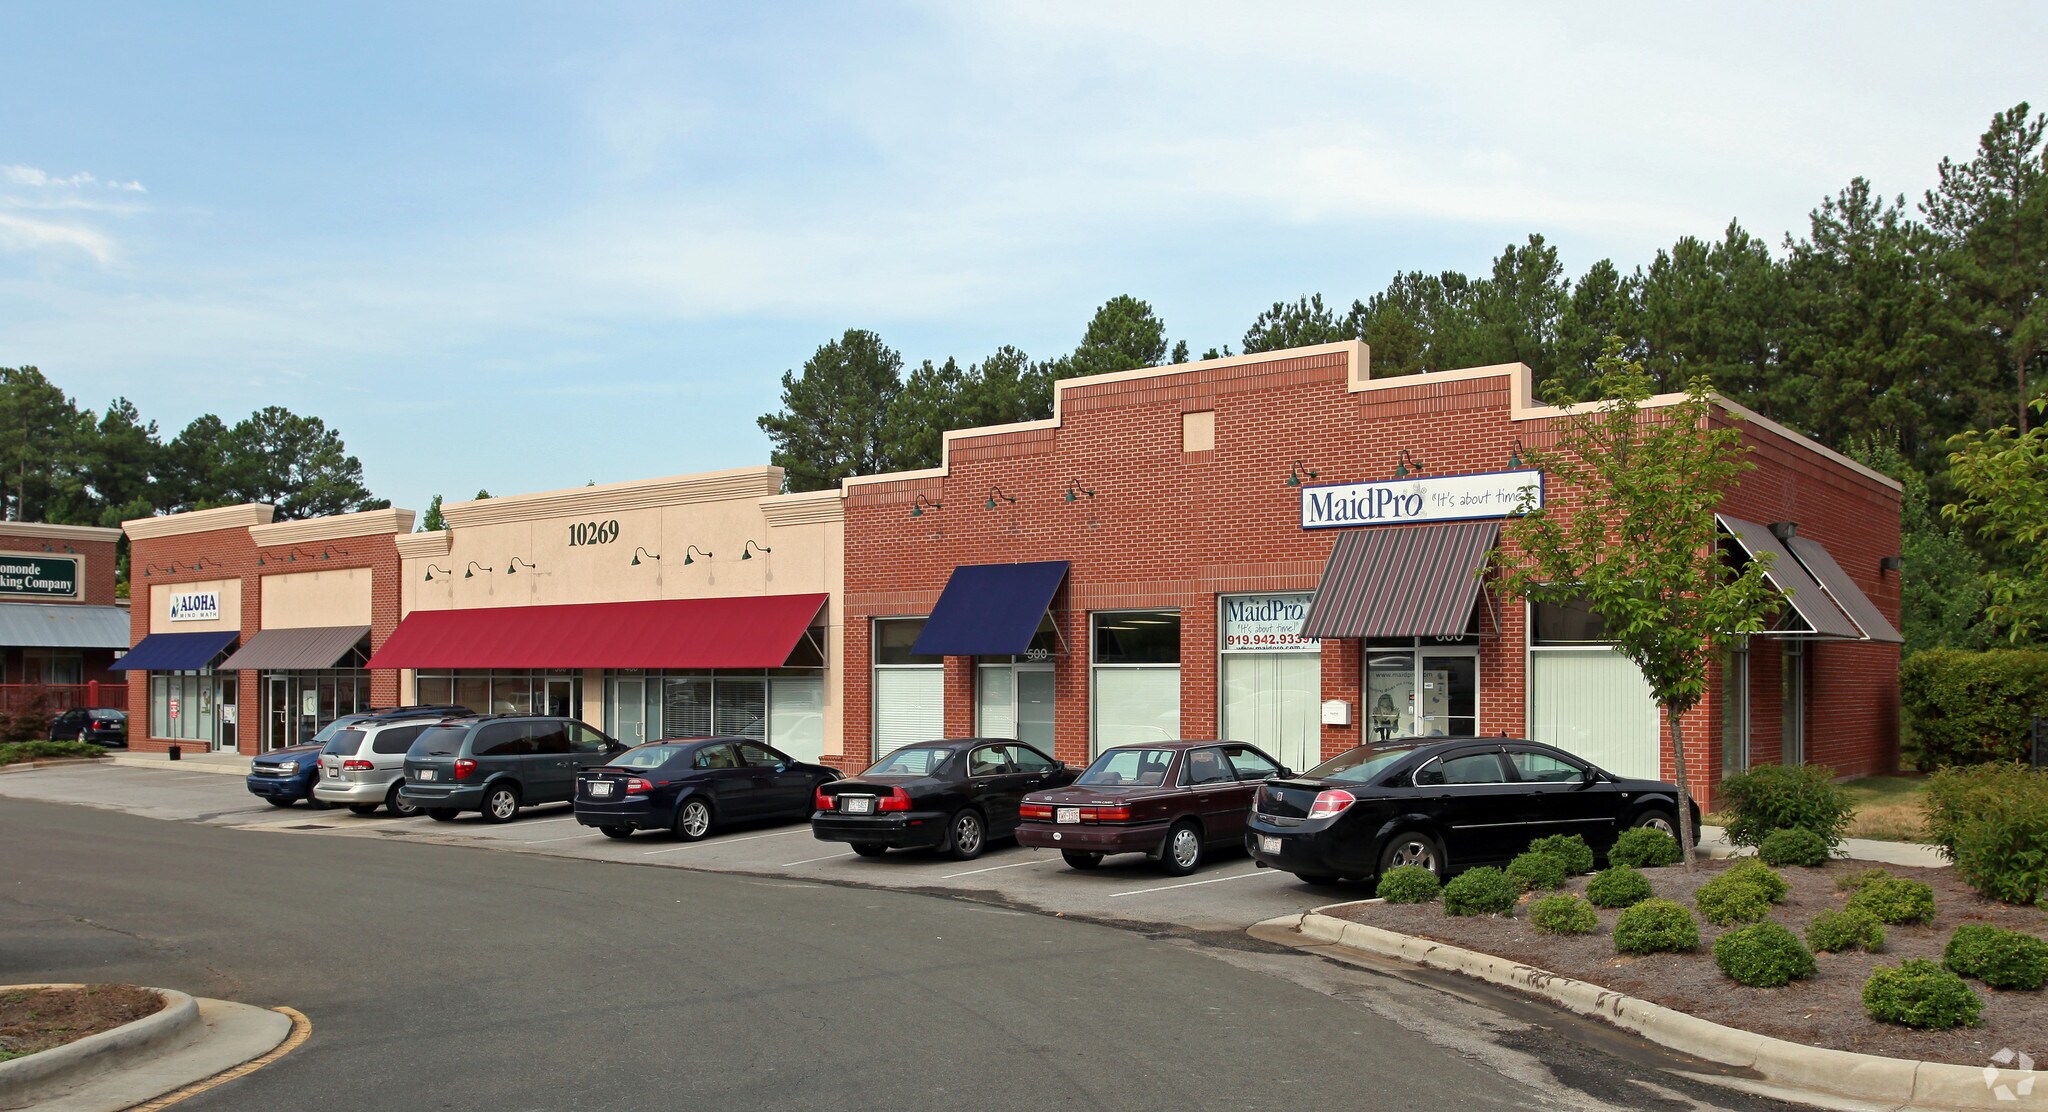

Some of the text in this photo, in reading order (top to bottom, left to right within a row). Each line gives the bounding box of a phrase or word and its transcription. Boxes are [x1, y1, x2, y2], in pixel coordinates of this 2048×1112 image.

[1309, 487, 1423, 523] MaidPro
[1459, 489, 1491, 506] about
[1496, 487, 1522, 504] time
[568, 519, 619, 547] 10269
[0, 562, 41, 575] omonde
[0, 574, 73, 592] king Company
[180, 594, 216, 611] ALOHA
[1227, 599, 1304, 622] MaidPro
[1255, 623, 1273, 633] about
[1227, 633, 1310, 645] 919.942.9339
[1027, 648, 1048, 659] 500
